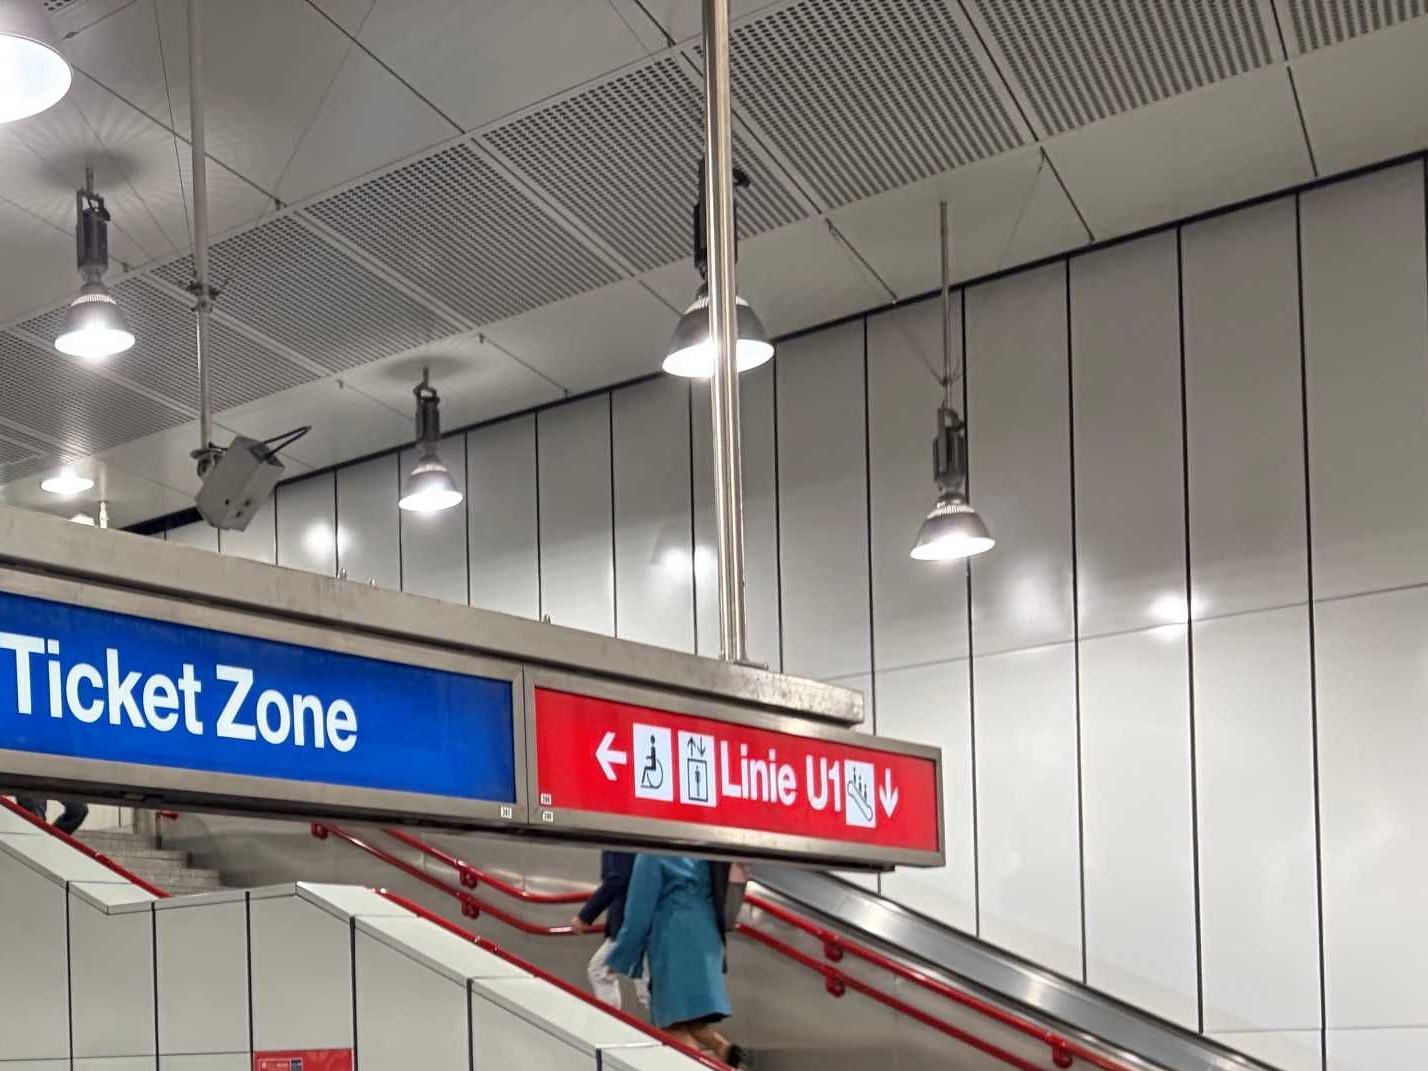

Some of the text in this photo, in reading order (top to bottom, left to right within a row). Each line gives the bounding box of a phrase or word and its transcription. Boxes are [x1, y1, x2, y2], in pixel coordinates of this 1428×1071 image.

[215, 664, 358, 752] Zone
[720, 740, 842, 812] Linie U1
